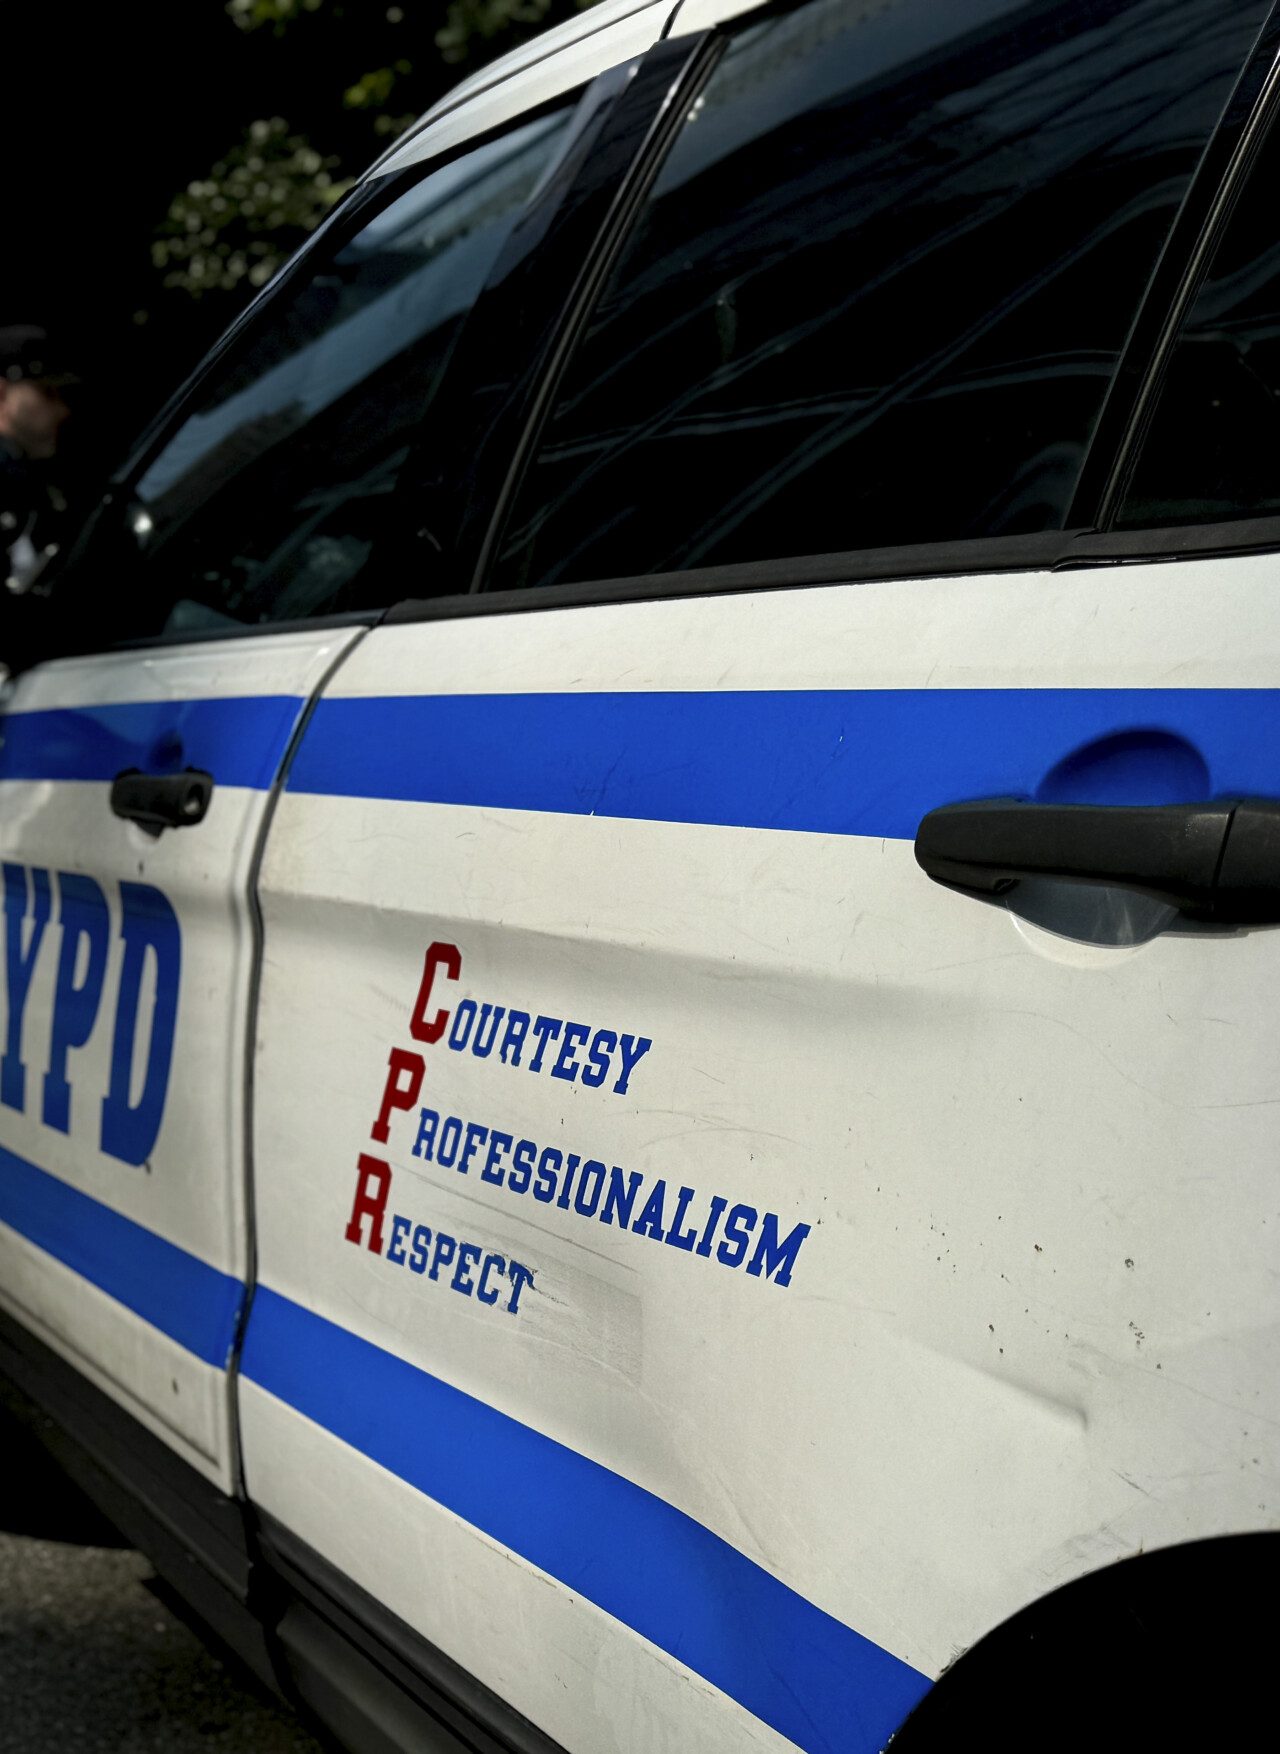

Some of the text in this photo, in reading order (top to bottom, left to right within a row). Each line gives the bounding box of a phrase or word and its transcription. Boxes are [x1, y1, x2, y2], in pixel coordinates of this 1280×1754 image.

[409, 941, 652, 1095] COURTESY
[345, 1152, 535, 1315] RESPECT
[370, 1047, 812, 1288] PROFESSIONALISM
